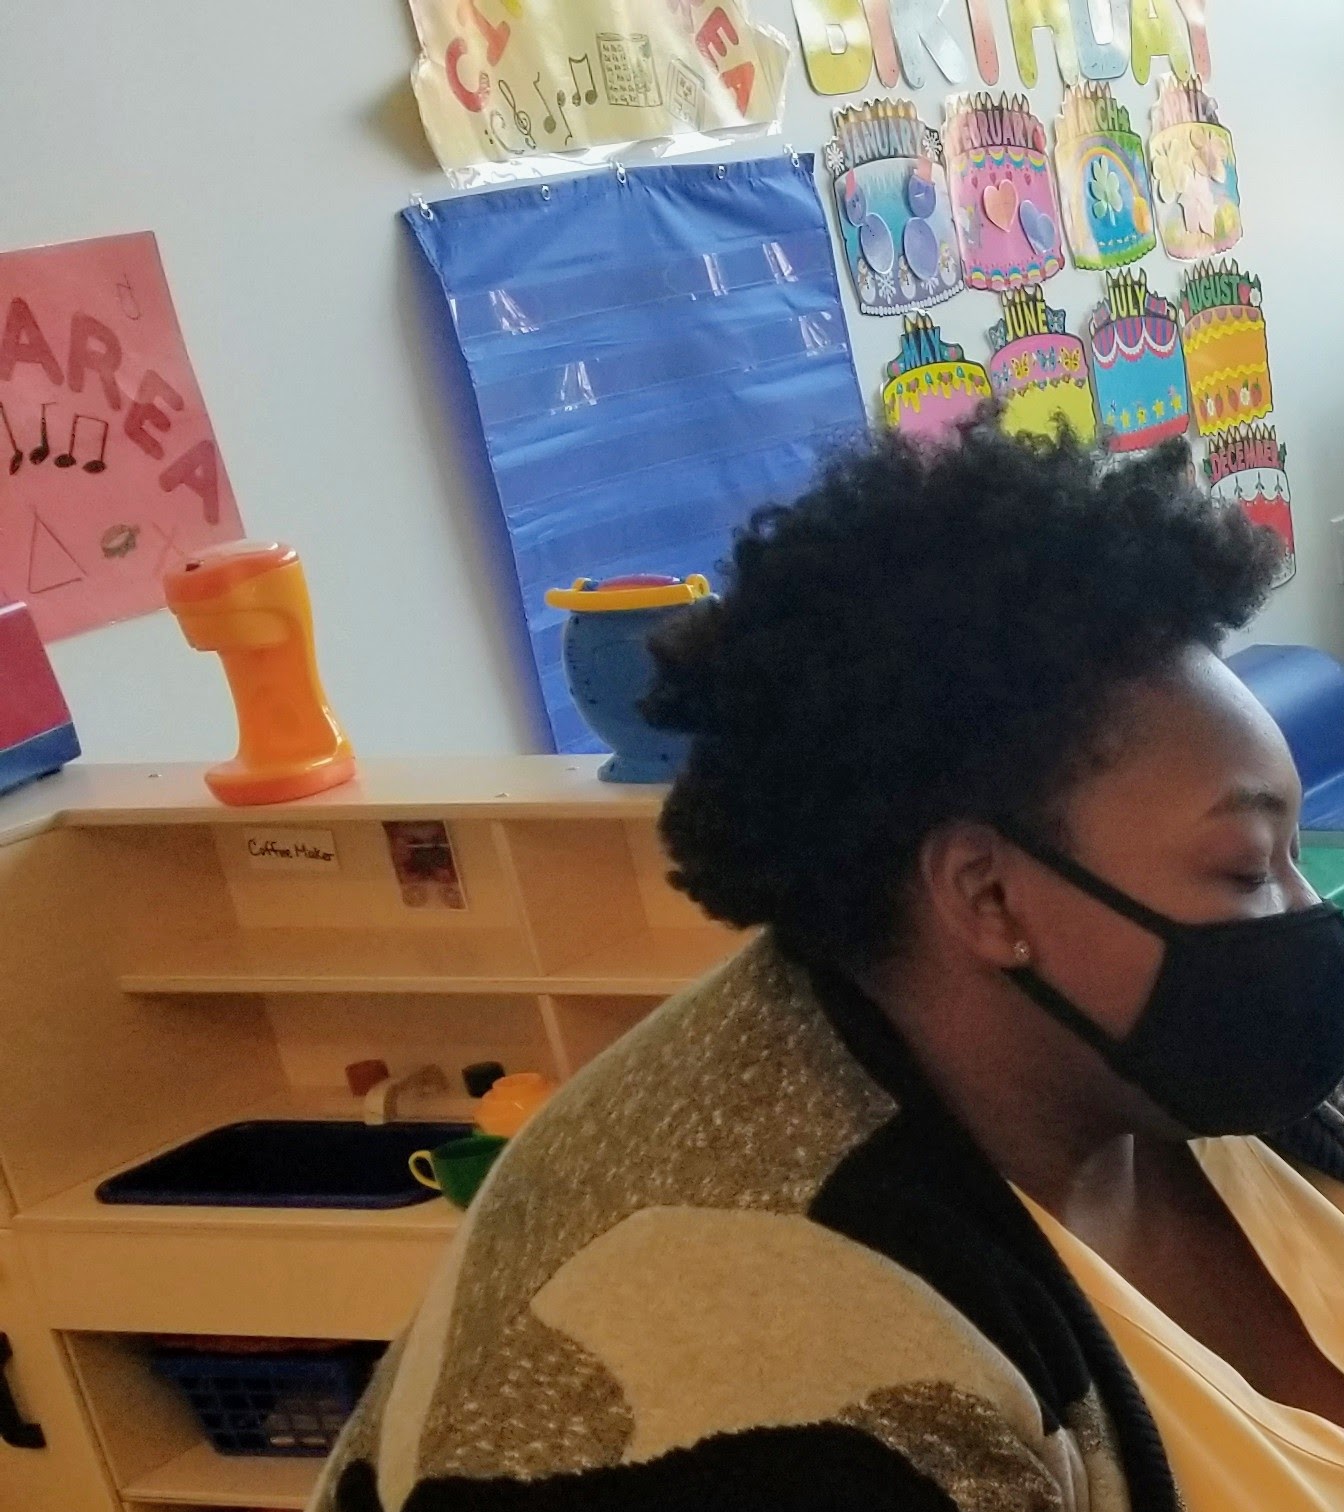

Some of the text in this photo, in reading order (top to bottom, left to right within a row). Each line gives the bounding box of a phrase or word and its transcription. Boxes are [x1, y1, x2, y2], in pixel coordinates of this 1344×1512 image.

[843, 117, 926, 166] JANUARY
[1108, 285, 1147, 321] JULY
[1187, 274, 1240, 316] AUGUST
[1005, 298, 1048, 340] JUNE
[899, 326, 943, 372] MAY
[0, 297, 220, 526] AREA
[1209, 439, 1281, 483] DECEMBER
[248, 839, 335, 862] Coffee Maker
